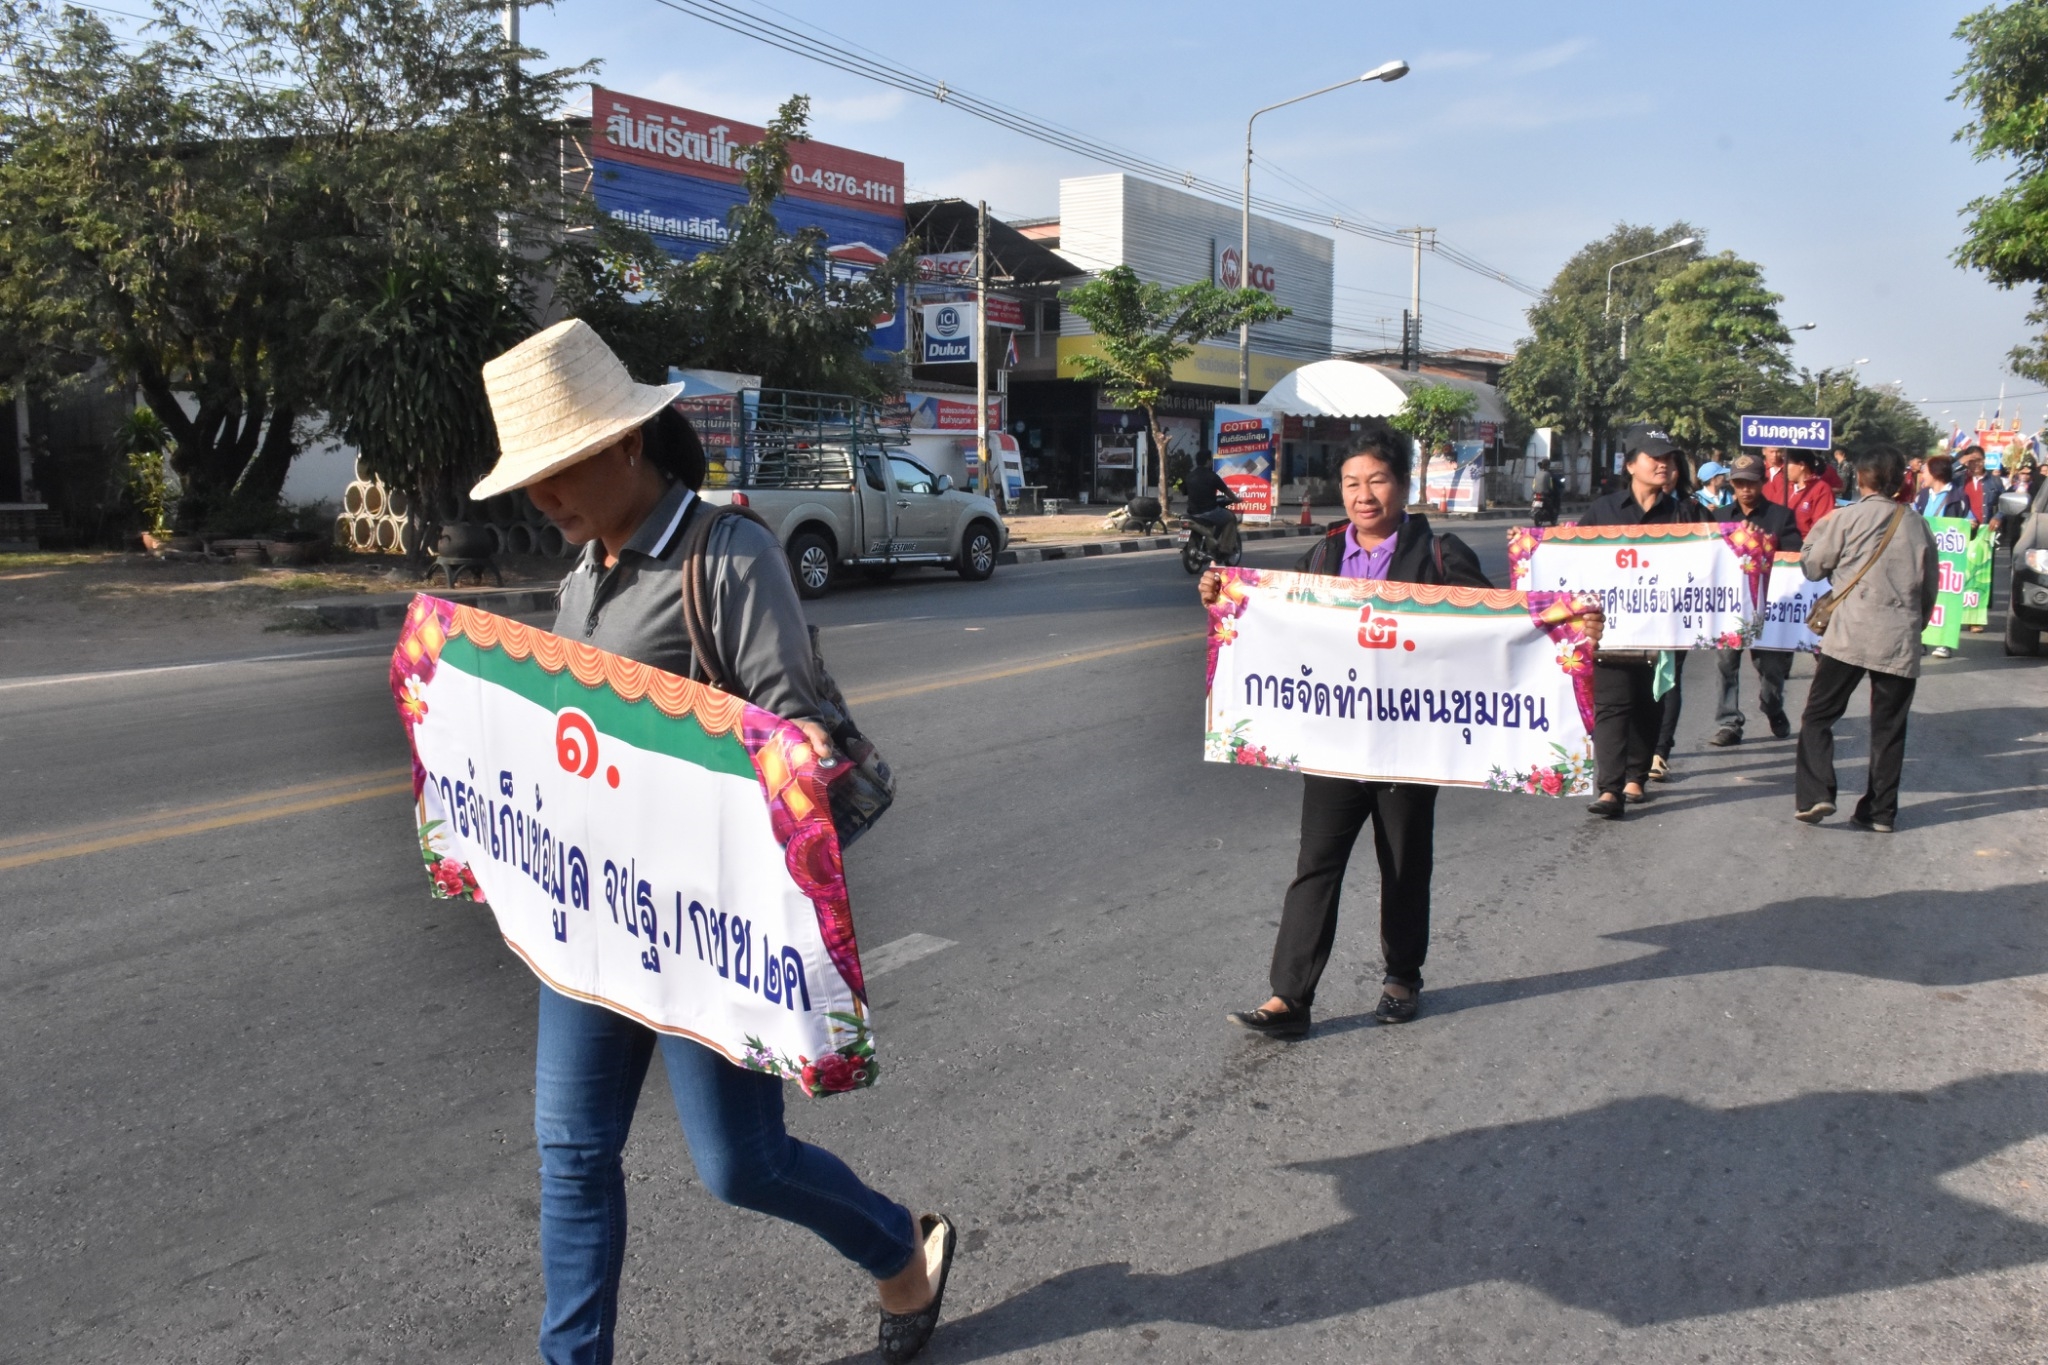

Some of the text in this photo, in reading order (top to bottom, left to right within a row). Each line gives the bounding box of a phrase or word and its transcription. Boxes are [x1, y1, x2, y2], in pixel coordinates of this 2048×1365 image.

[790, 164, 895, 205] 0-4376-1111
[940, 313, 955, 325] ICI
[928, 343, 967, 357] Dulux
[1224, 420, 1258, 432] COTTO
[1747, 420, 1826, 445] อำเภอกุดรัง
[1616, 548, 1650, 569] ๓.
[1357, 604, 1416, 652] ๒.
[1244, 664, 1550, 745] การจัดทำแผนชุมชน
[556, 711, 620, 789] ๑.
